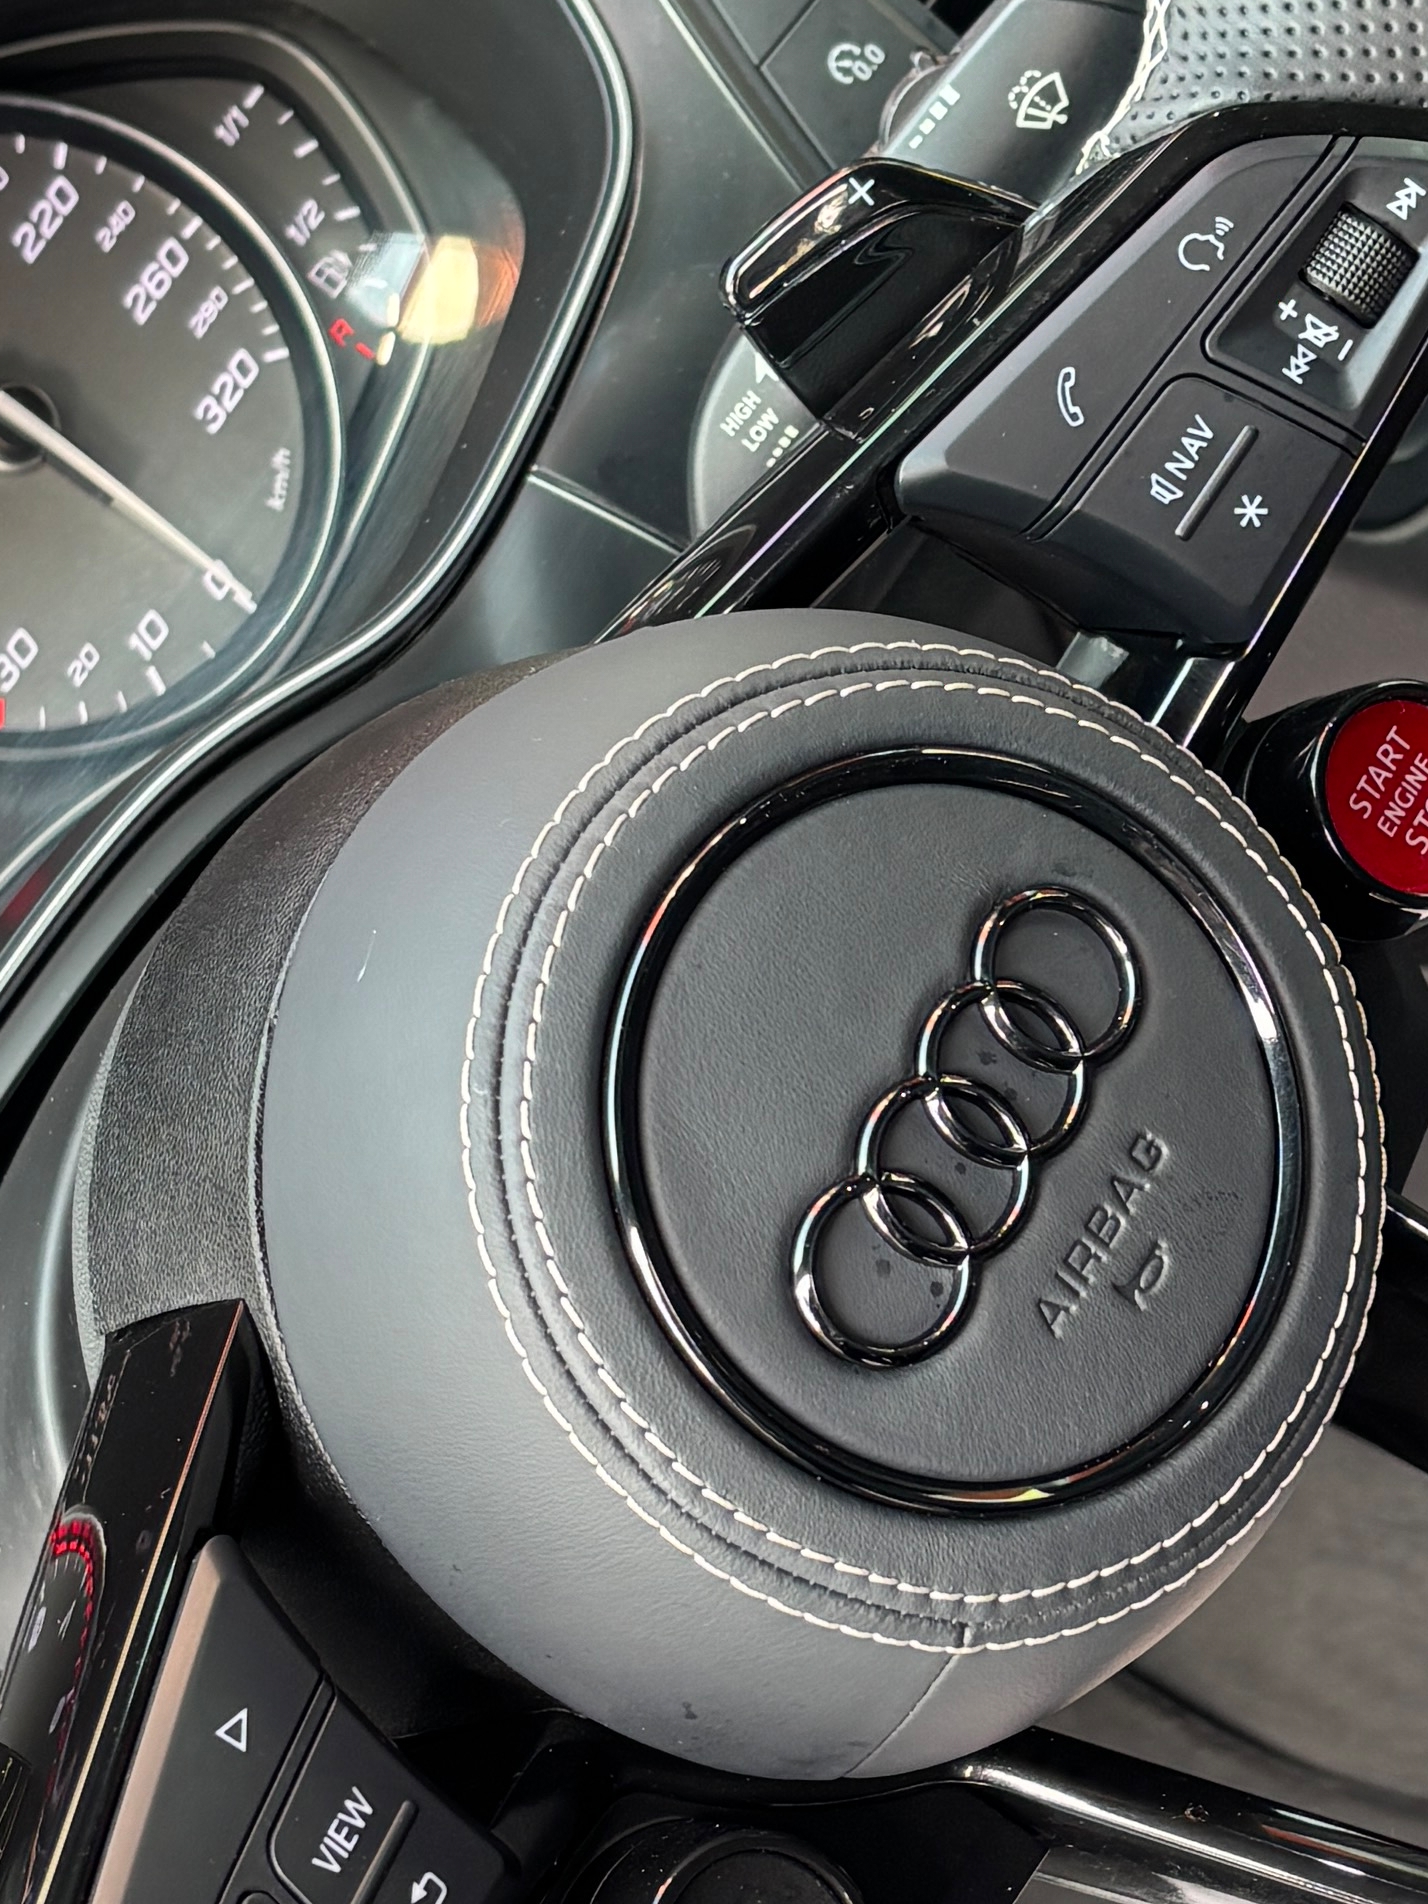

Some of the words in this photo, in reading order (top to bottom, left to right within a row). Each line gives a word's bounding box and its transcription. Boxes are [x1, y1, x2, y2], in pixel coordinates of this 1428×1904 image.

[12, 176, 79, 264] 220
[96, 201, 135, 252] 240
[124, 237, 189, 325] 260
[189, 286, 228, 338] 290
[195, 348, 259, 434] 320
[720, 390, 761, 436] HIGH
[741, 407, 779, 452] LOW
[1165, 414, 1213, 480] NAV
[266, 448, 290, 511] km/h
[67, 643, 99, 687] 20
[128, 610, 169, 660] 10
[1350, 726, 1410, 818] START
[1031, 1127, 1169, 1339] AIRBAG
[312, 1787, 372, 1872] VIEW
